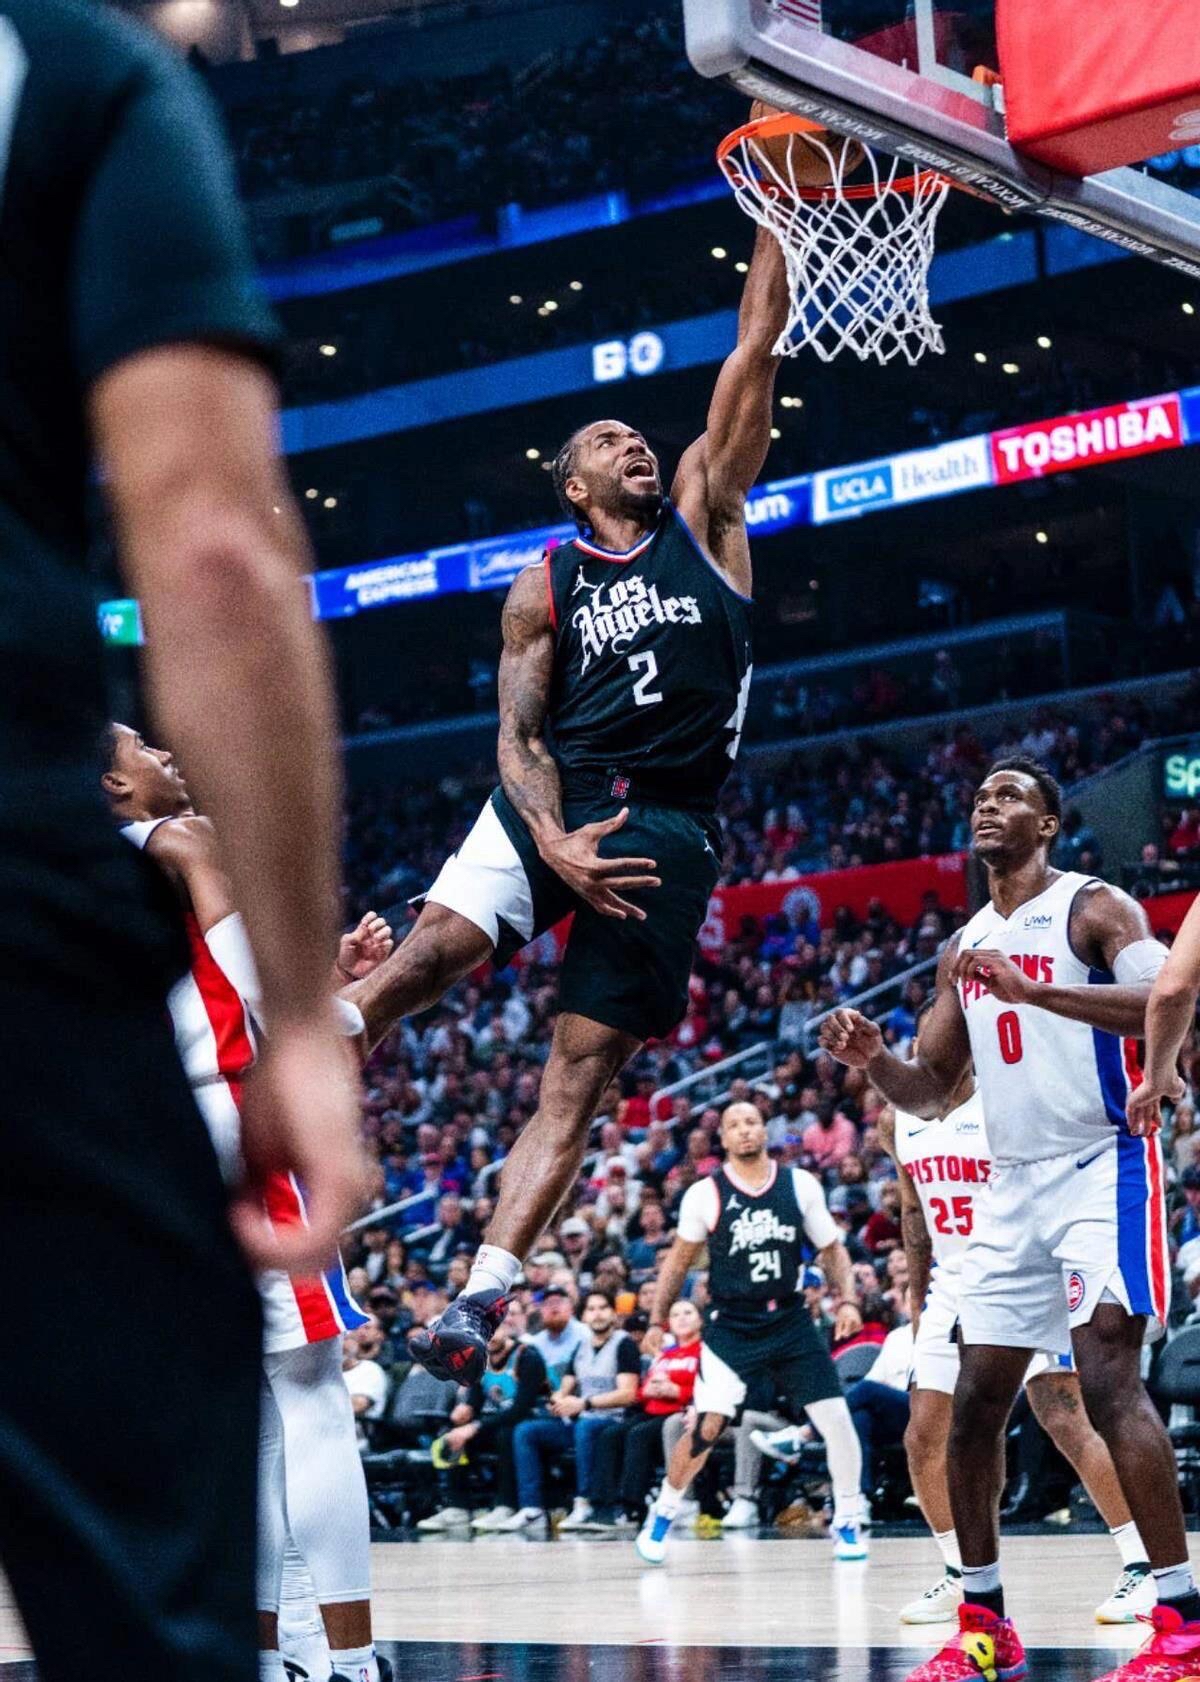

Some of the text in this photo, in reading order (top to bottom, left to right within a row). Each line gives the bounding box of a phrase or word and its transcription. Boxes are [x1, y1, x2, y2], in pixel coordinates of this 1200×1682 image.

[998, 405, 1174, 472] TOSHIBA
[832, 451, 980, 505] UCLA Health
[591, 575, 647, 613] Los
[572, 584, 702, 675] Angeles
[627, 650, 664, 706] 2
[996, 1010, 1024, 1065] 0
[902, 1155, 992, 1184] PISTONS
[929, 1195, 974, 1236] 25
[748, 1250, 783, 1283] 24
